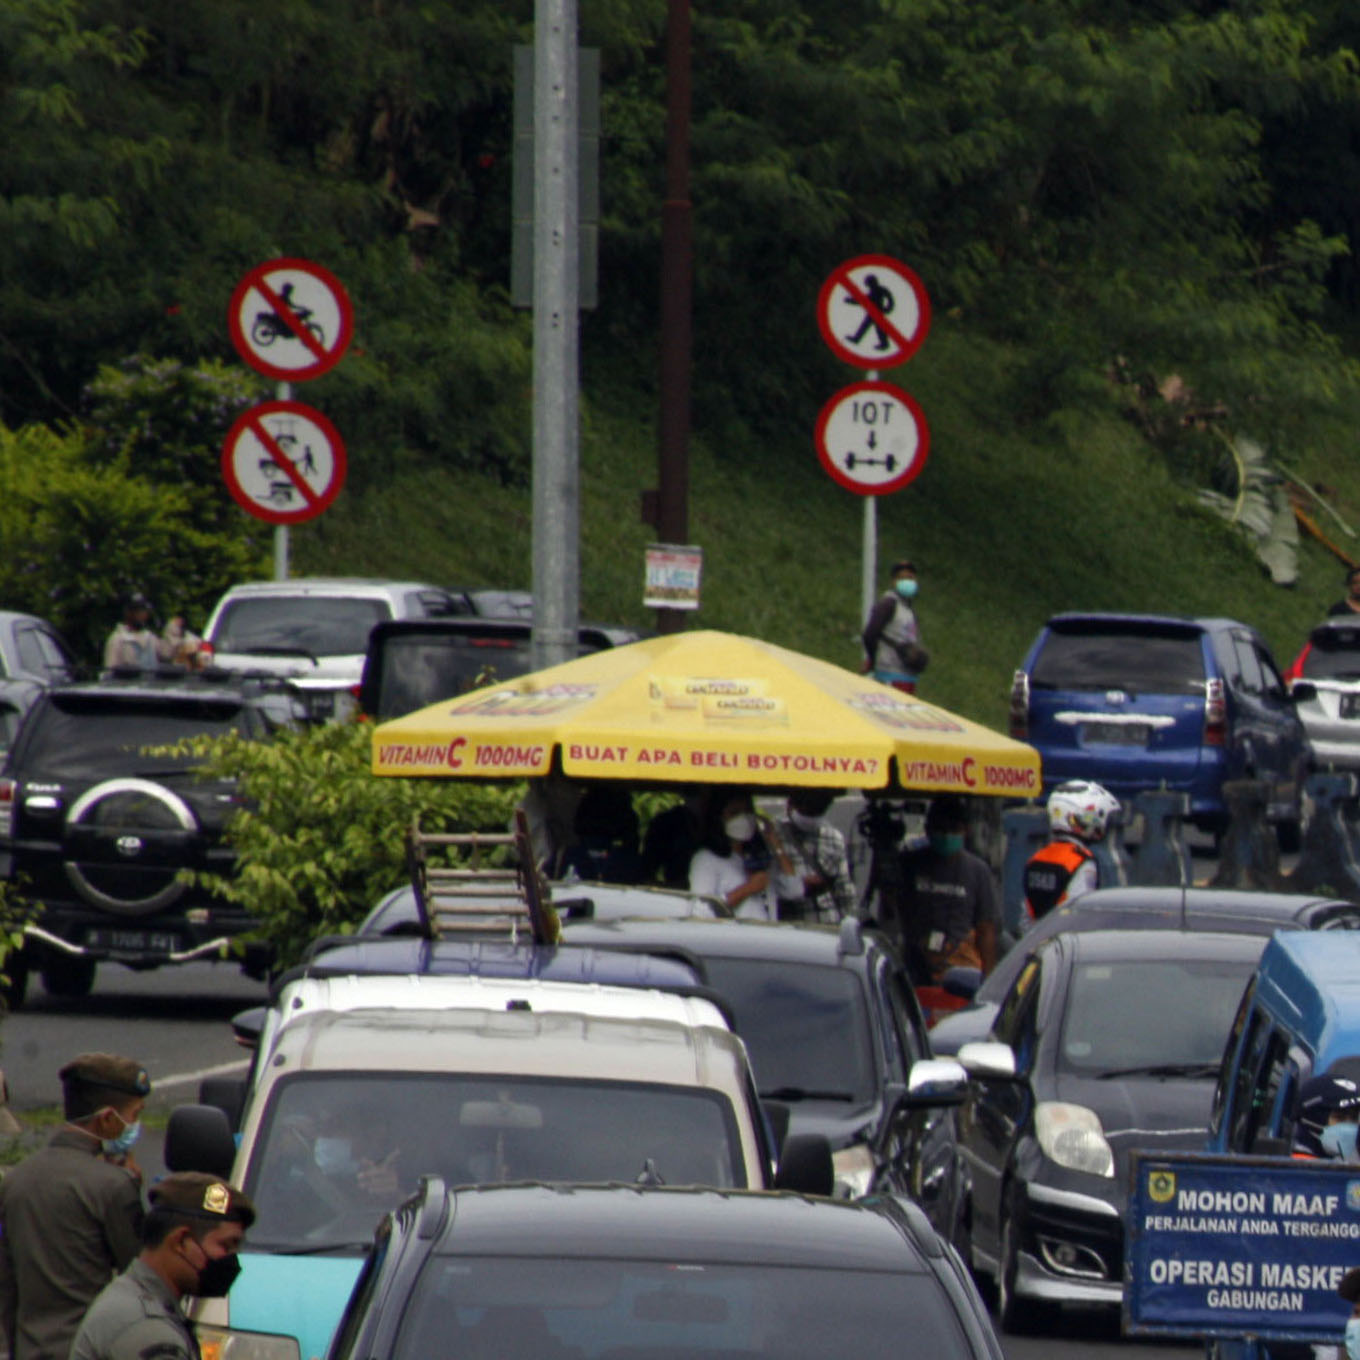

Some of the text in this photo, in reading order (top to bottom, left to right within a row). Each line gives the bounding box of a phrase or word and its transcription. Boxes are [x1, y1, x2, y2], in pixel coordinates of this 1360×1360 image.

[853, 401, 894, 425] 10T
[475, 745, 544, 767] 1000MG
[569, 744, 879, 774] BUAT APA BELI BOTOLNYA?
[984, 766, 1035, 789] 1000MG
[1177, 1190, 1339, 1216] MOHON MAAF
[1145, 1215, 1238, 1234] PERJALANAN
[1241, 1219, 1279, 1235] ANDA
[1150, 1259, 1354, 1291] OPERASI MASKE
[1207, 1289, 1303, 1311] GABUNGAN
